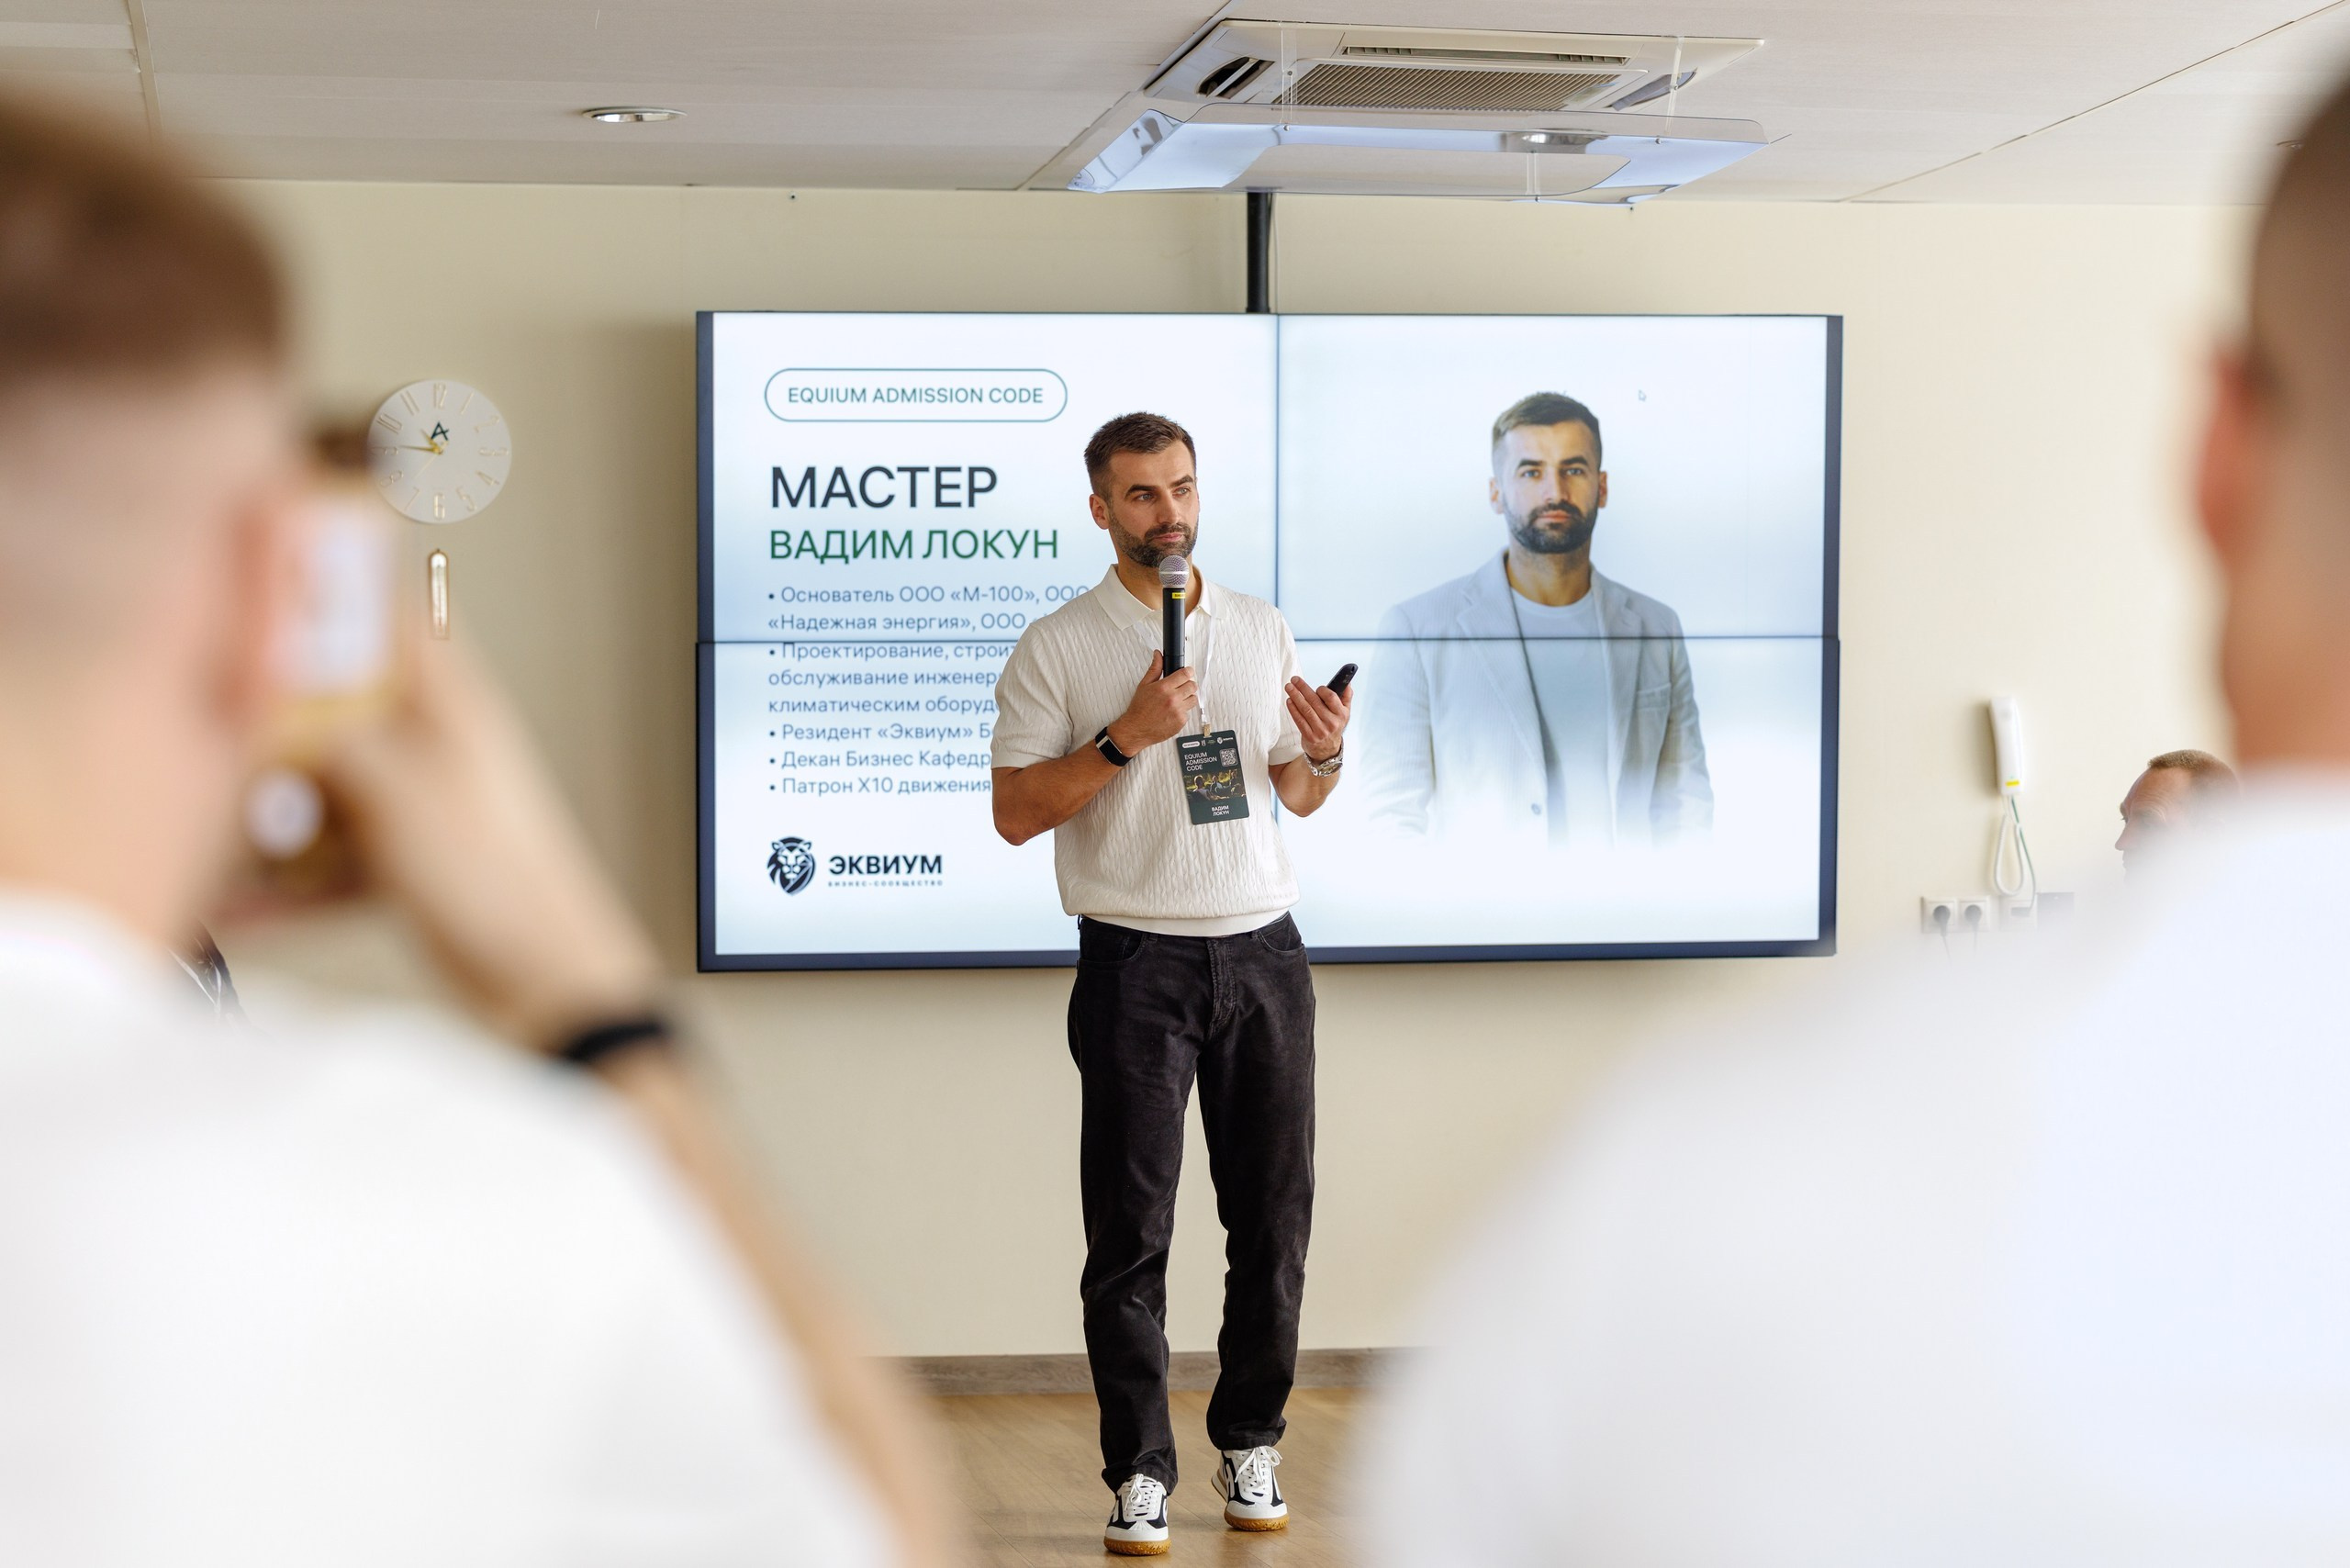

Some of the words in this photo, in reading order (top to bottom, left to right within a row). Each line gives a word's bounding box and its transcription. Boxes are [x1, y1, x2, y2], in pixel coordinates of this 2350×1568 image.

[432, 382, 448, 409] 12
[788, 387, 867, 405] EQUIUM
[872, 386, 984, 404] ADMISSION
[989, 386, 1044, 404] CODE
[770, 465, 998, 509] МАСТЕР
[770, 529, 913, 565] ВАДИМ
[923, 529, 1058, 559] ЛОКУН
[781, 586, 894, 602] Основатель
[900, 586, 945, 602] ООО
[950, 585, 1040, 604] «М-100»,
[767, 614, 877, 632] «Надежная
[882, 616, 976, 633] энергия»,
[980, 612, 1026, 630] ООО
[782, 642, 949, 661] Проектирование,
[768, 669, 909, 689] обслуживание
[913, 672, 1001, 688] инженер
[768, 700, 920, 713] климатическим
[782, 723, 872, 742] Резидент
[878, 722, 973, 743] «Эквиум»
[781, 751, 841, 769] Декан
[845, 750, 913, 767] Бизнес
[1184, 751, 1208, 760] EQUIUM
[1185, 756, 1218, 767] ADMISSION
[1186, 764, 1203, 772] CODE
[782, 777, 854, 797] Патрон
[898, 779, 991, 795] движения
[829, 855, 943, 875] ЭКВИУМ
